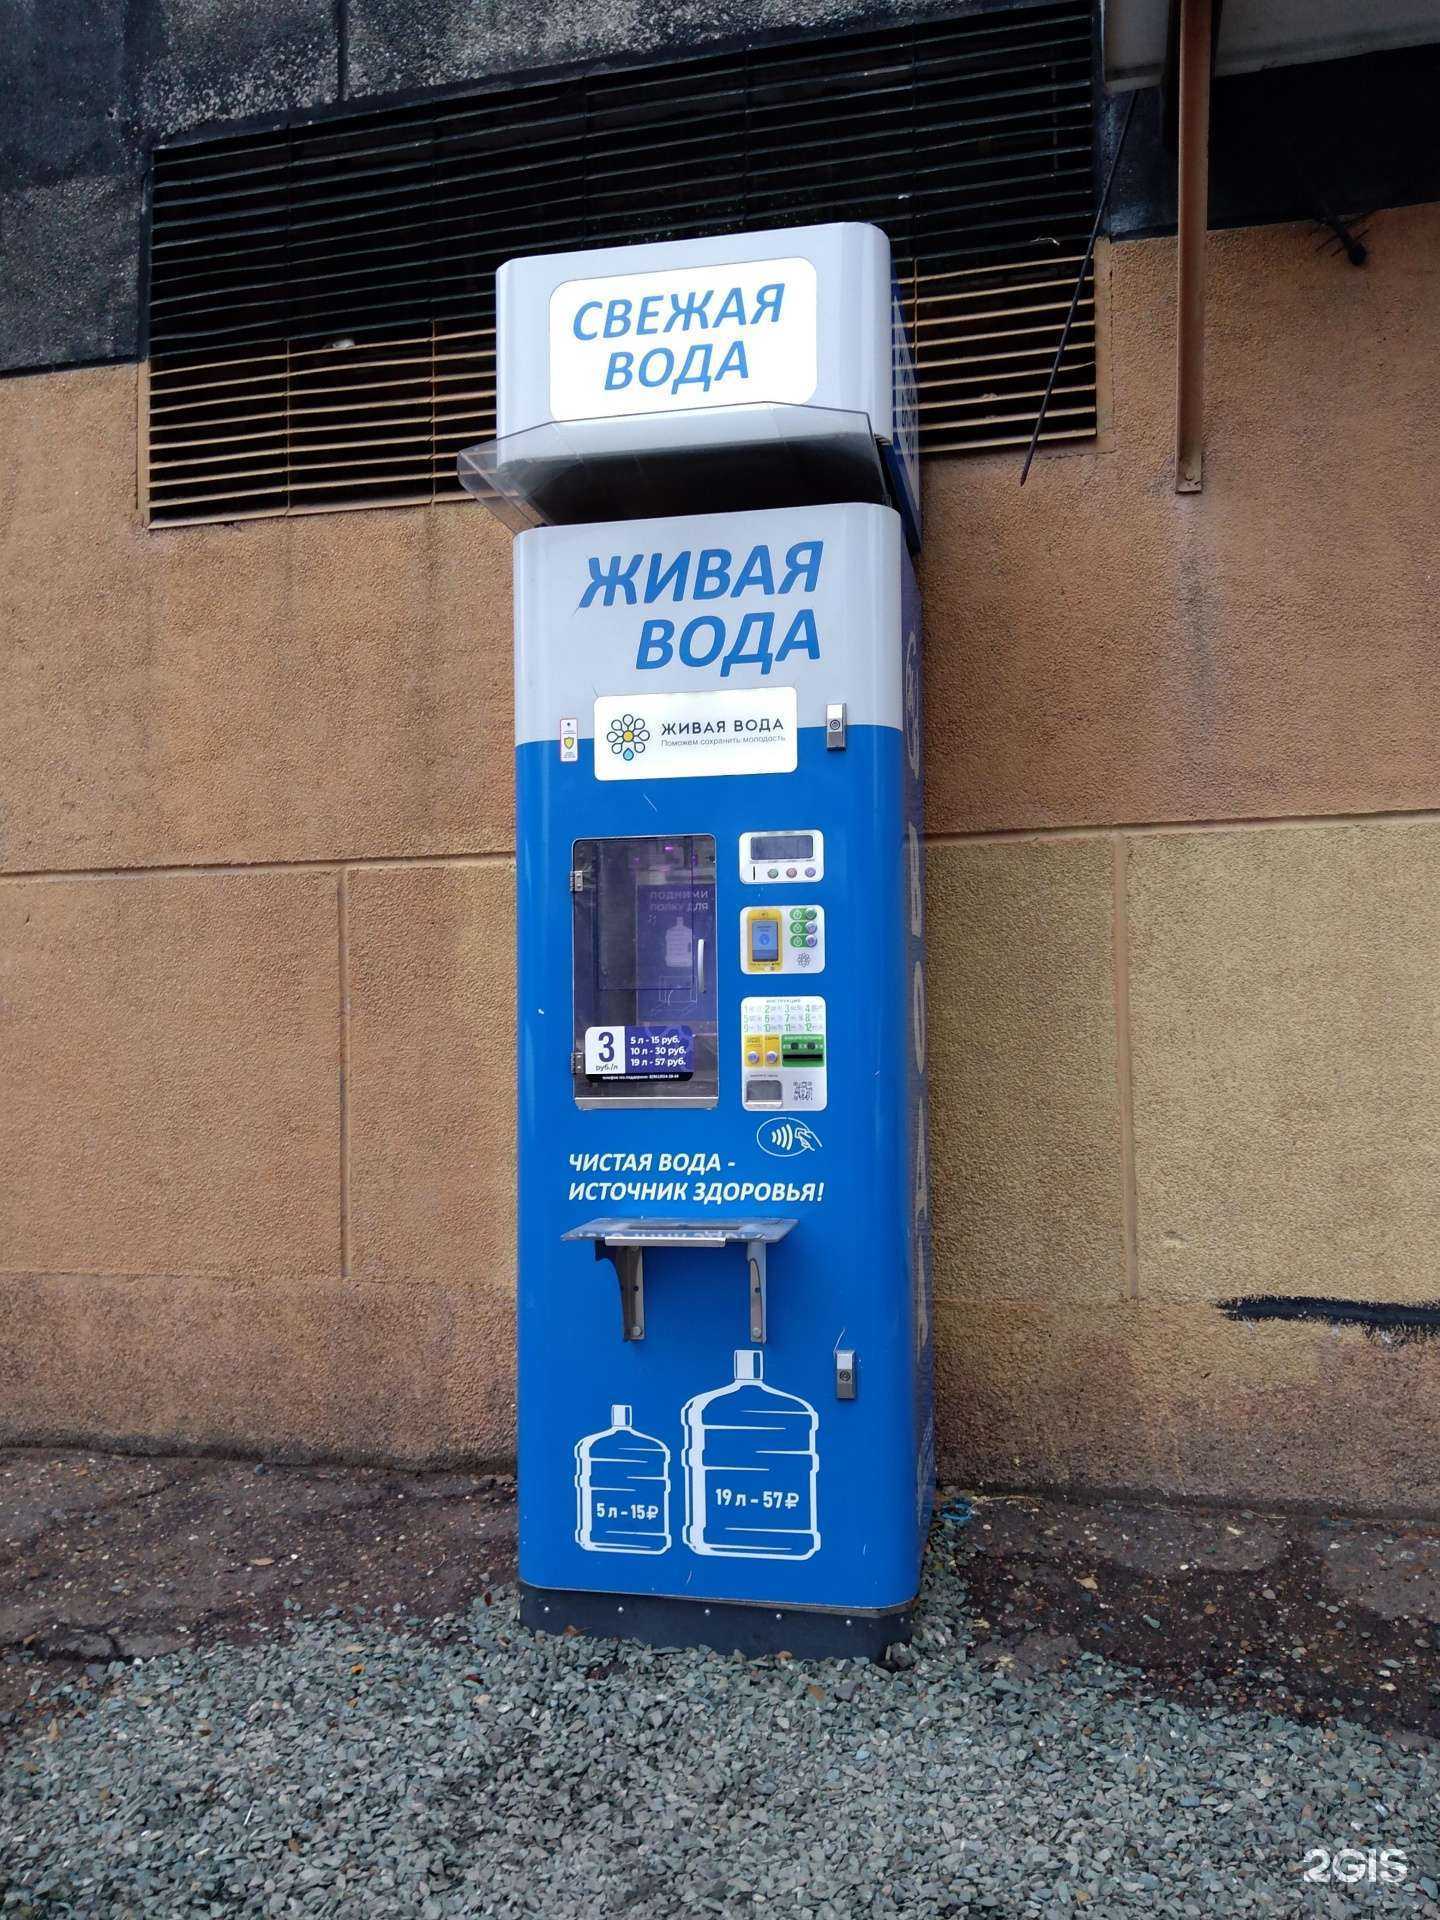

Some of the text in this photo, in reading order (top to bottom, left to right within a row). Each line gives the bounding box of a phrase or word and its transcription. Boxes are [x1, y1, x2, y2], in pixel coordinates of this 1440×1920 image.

[573, 282, 786, 341] СВЕЖАЯ
[604, 340, 750, 395] ВОДА
[578, 540, 825, 609] ЖИВАЯ
[635, 608, 821, 678] ВОДА
[661, 718, 784, 736] ЖИВАЯ ВОДА
[661, 739, 699, 747] Поможем
[700, 737, 741, 745] сохранить
[598, 1031, 615, 1062] 3
[630, 1036, 637, 1044] 5
[651, 1036, 660, 1044] 15
[661, 1035, 680, 1045] руб.
[630, 1047, 640, 1055] 10
[667, 1046, 687, 1056] руб.
[595, 1063, 618, 1072] руб./л
[655, 1058, 666, 1066] 57
[667, 1057, 686, 1067] руб.
[568, 1153, 653, 1172] ЧИСТАЯ
[658, 1153, 721, 1175] ВОДА
[568, 1182, 825, 1205] ИСТОЧНИК ЗДОРОВЬЯ!
[715, 1488, 732, 1506] 19
[735, 1494, 747, 1506] л
[596, 1503, 605, 1517] 5
[607, 1508, 618, 1518] л
